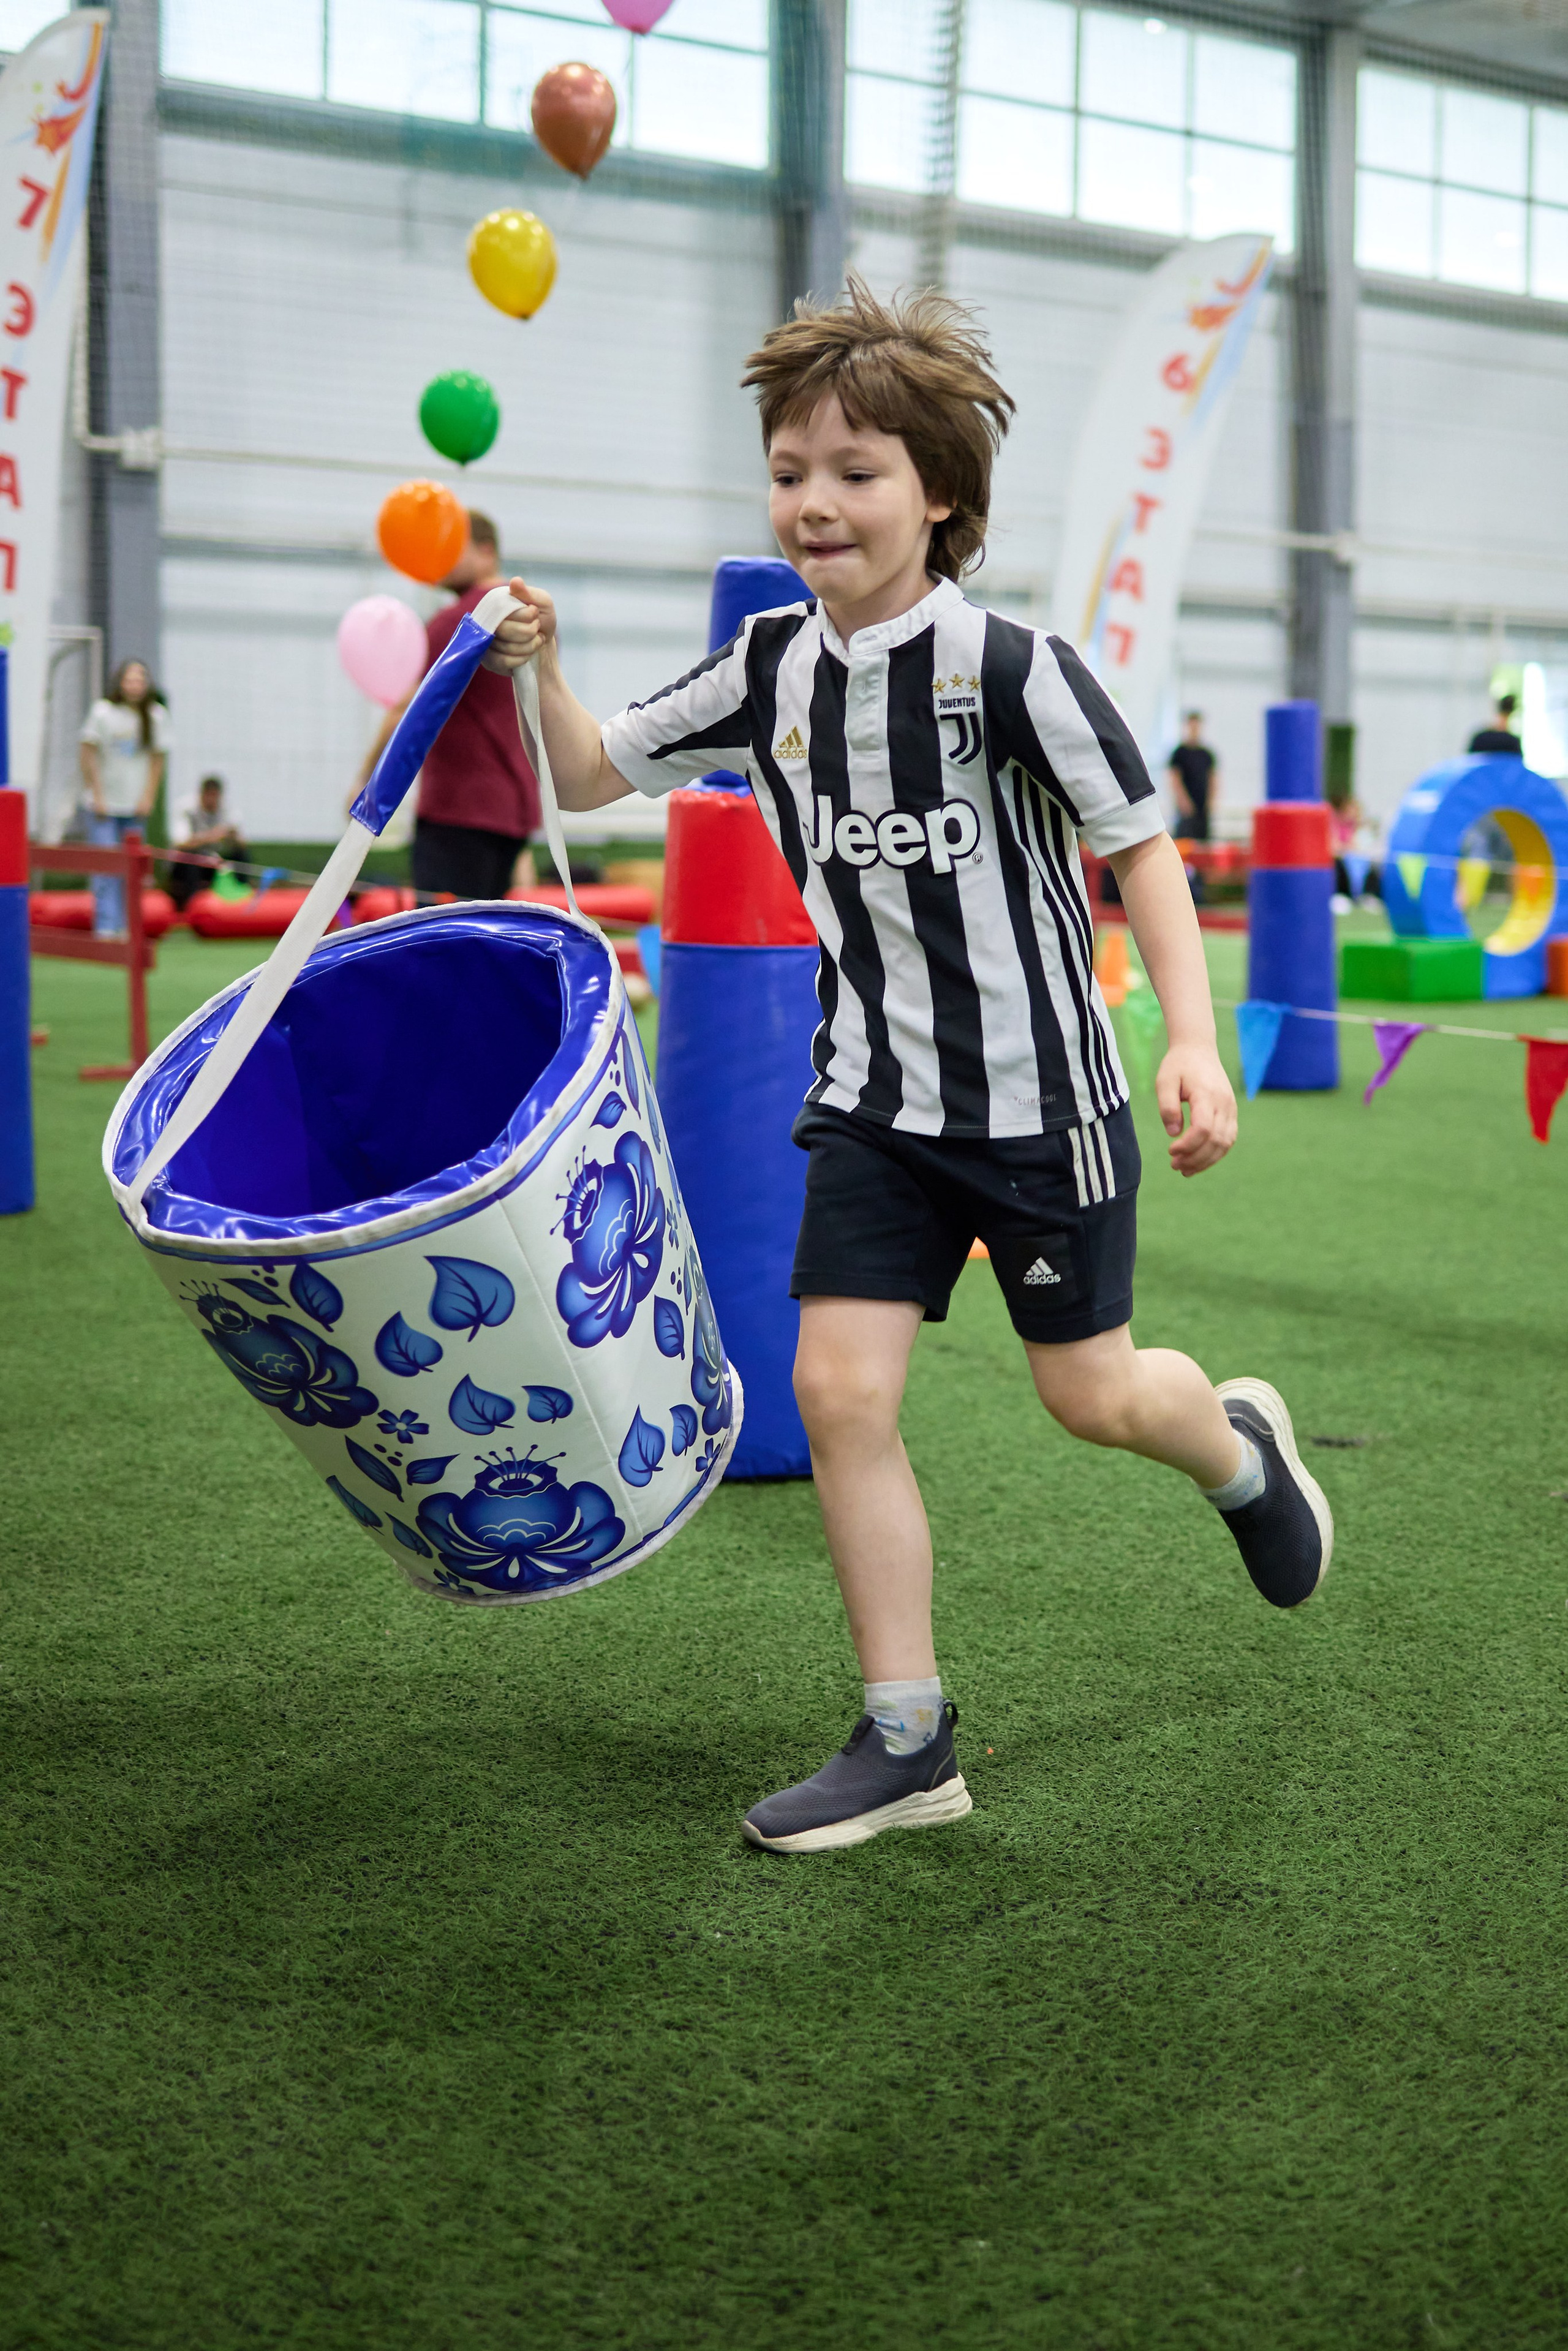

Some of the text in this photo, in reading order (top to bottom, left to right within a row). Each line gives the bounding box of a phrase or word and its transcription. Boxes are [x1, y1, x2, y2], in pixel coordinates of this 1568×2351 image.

[18, 176, 49, 227] 7
[1162, 353, 1195, 391] 6
[938, 697, 976, 709] JUVENTUS
[774, 749, 807, 760] adidas
[802, 794, 981, 875] Jeep
[1023, 1273, 1061, 1285] adidas
